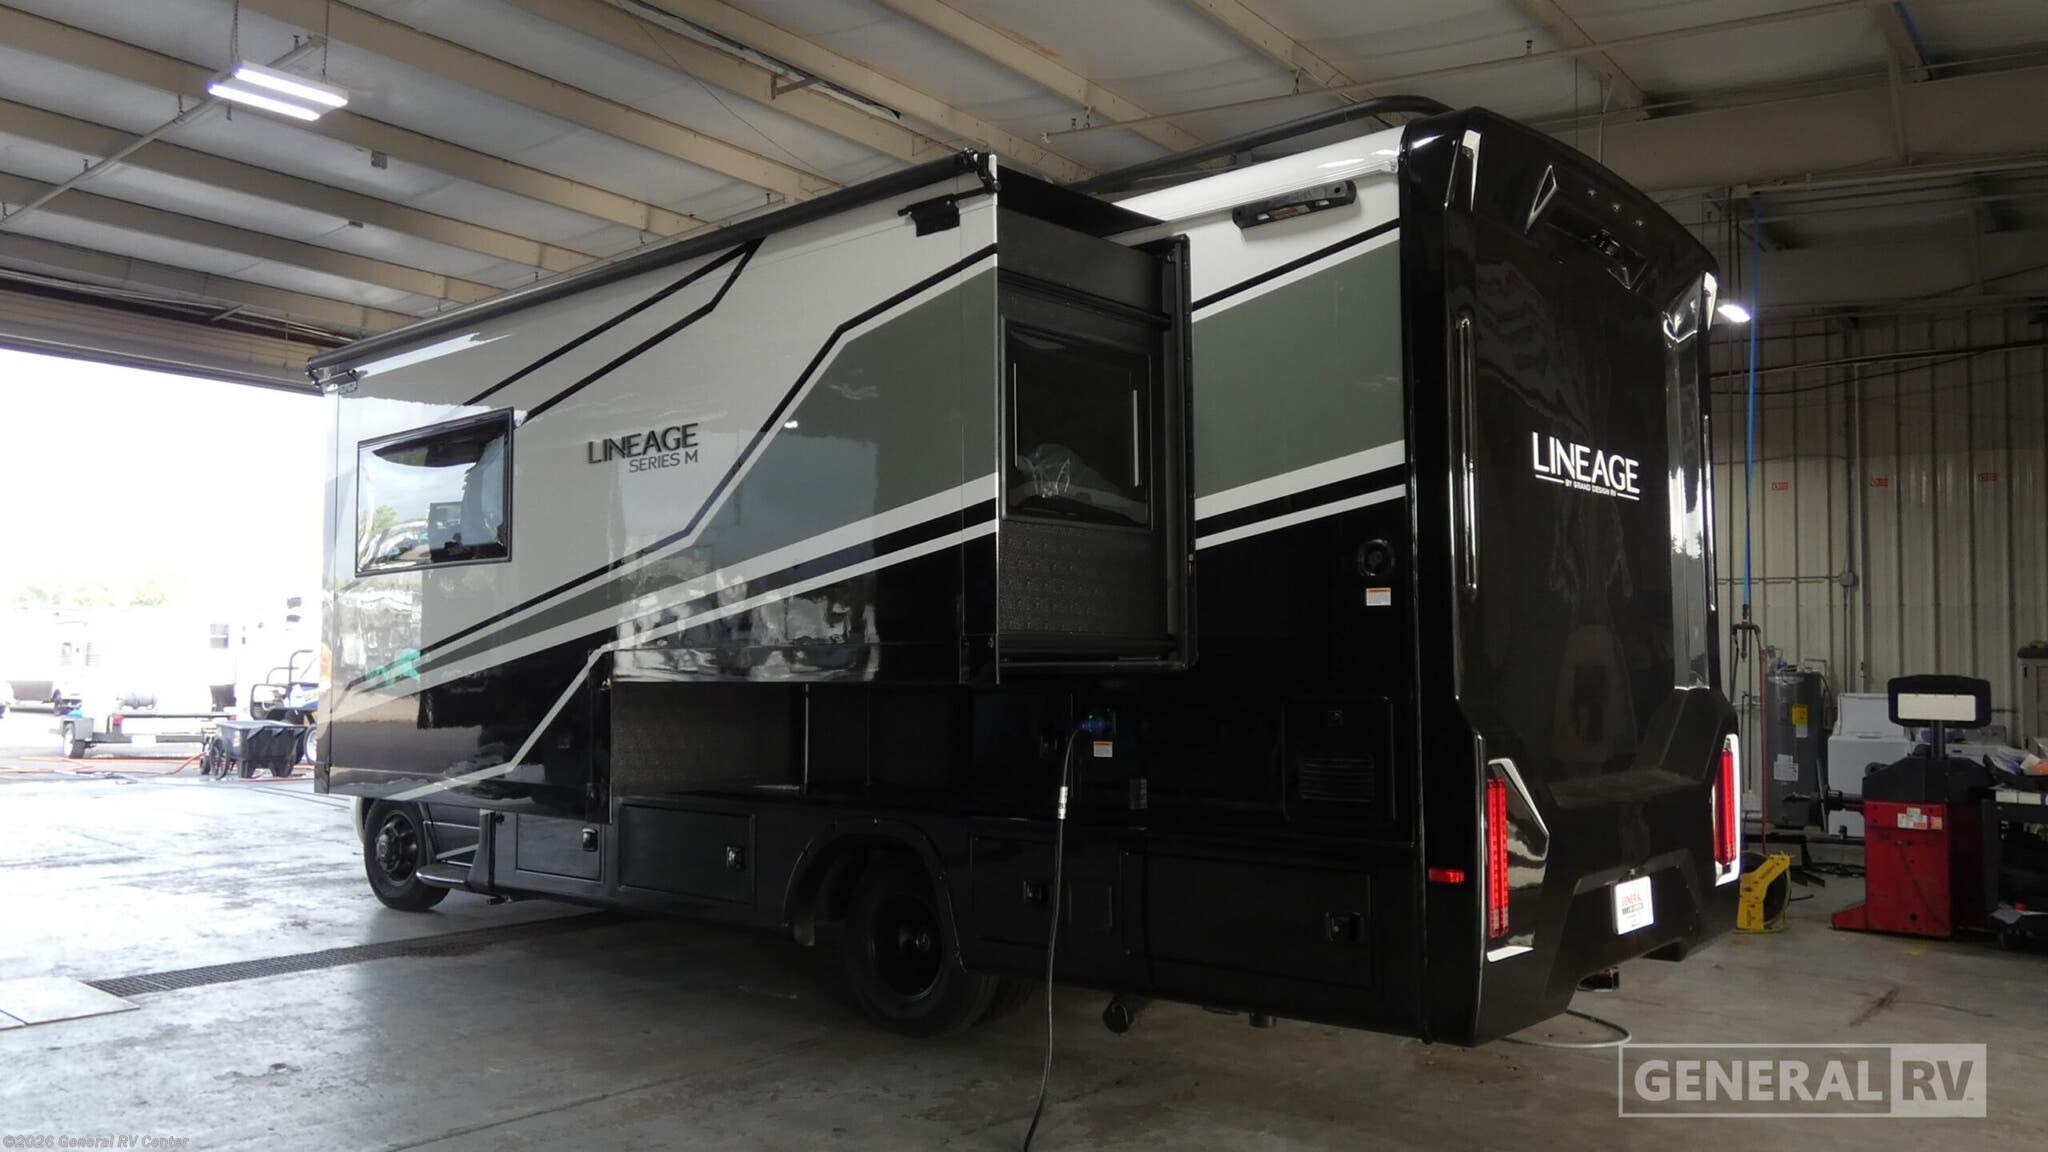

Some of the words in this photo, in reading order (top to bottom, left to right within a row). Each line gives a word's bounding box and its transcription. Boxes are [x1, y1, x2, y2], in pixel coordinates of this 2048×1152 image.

[588, 422, 699, 465] LINEAGE
[629, 453, 680, 472] SERIES
[685, 449, 698, 464] M
[1532, 431, 1640, 494] LINEAGE
